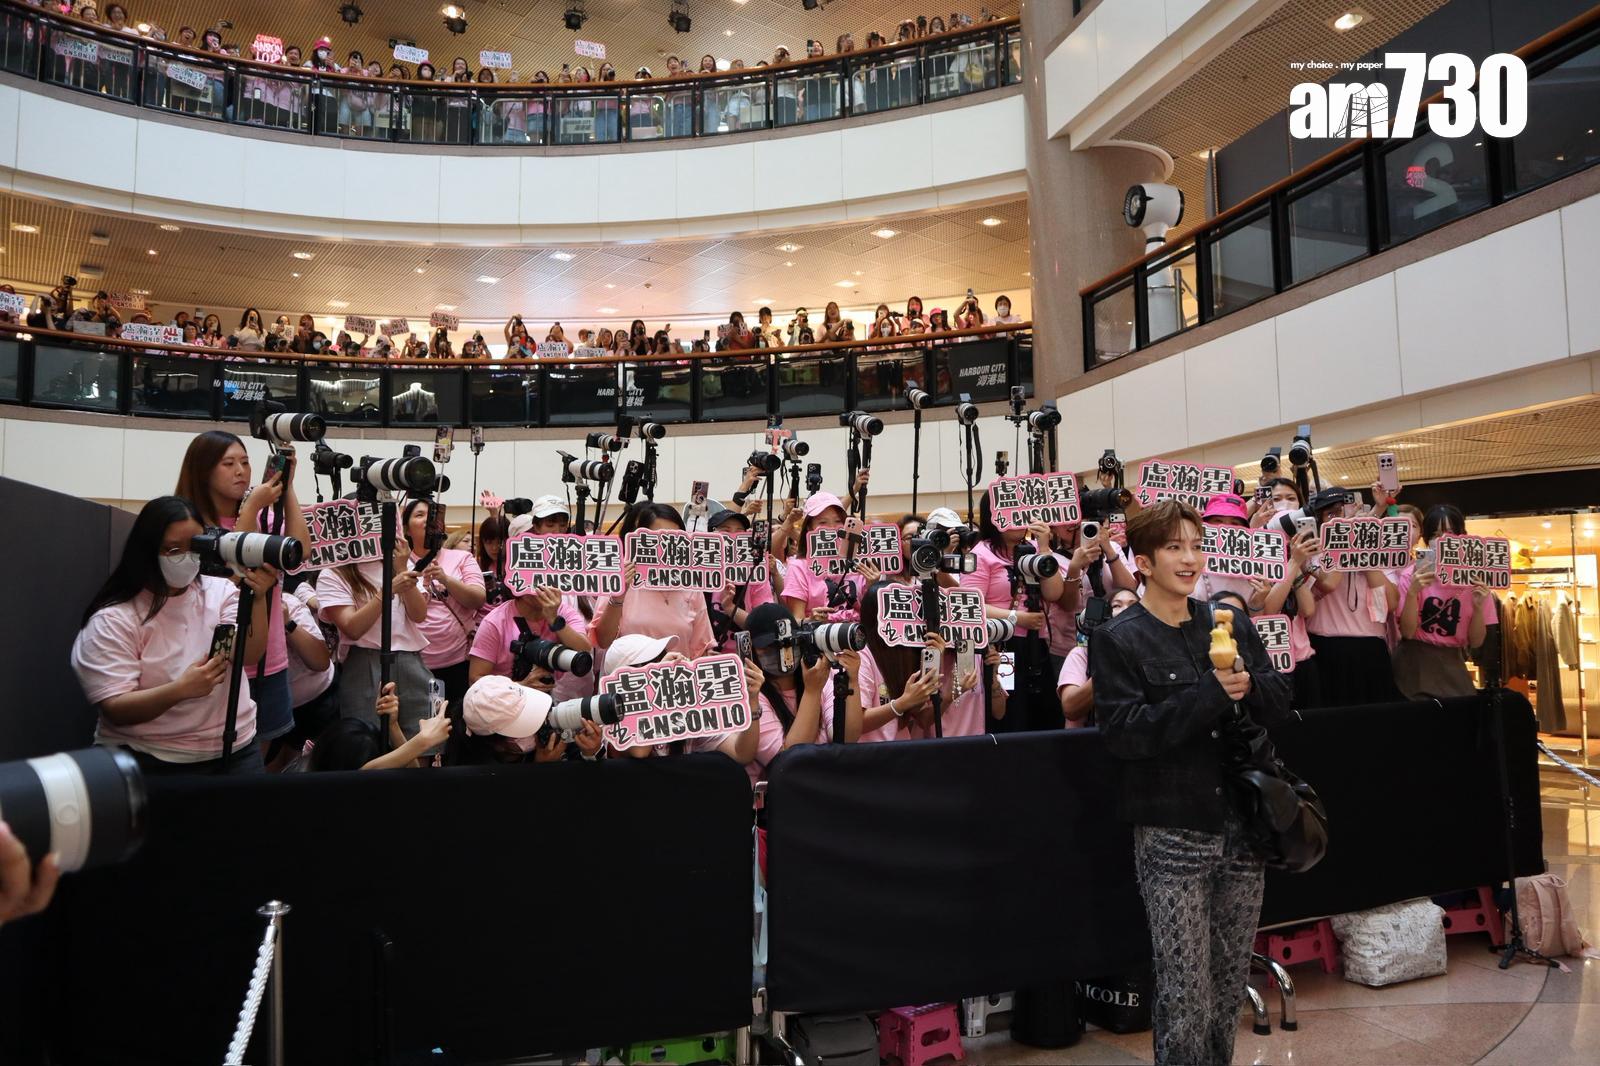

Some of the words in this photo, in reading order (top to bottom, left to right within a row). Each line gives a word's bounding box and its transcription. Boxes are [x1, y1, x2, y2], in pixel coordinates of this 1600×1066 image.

[960, 365, 990, 377] HARBOUR
[991, 363, 1005, 372] CITY
[248, 381, 265, 389] CITY
[1141, 463, 1231, 493] 盧瀚霆
[992, 477, 1077, 509] 盧瀚霆
[1013, 507, 1060, 526] ANSON
[1064, 505, 1078, 521] LO
[1325, 522, 1408, 549] 盧瀚霆
[309, 538, 376, 565] ANSON
[510, 537, 620, 572] 盧瀚霆
[630, 533, 721, 568] 盧瀚霆
[1340, 552, 1389, 567] ANSON
[1392, 551, 1406, 567] LO
[1440, 538, 1508, 568] 盧瀚霆
[885, 556, 899, 571] LO
[1208, 557, 1264, 576] ANSON
[1267, 564, 1283, 579] LO
[533, 573, 598, 592] ANSON
[602, 574, 620, 592] LO
[648, 568, 702, 588] ANSON
[705, 571, 721, 588] LO
[1452, 569, 1493, 586] ANSON
[1496, 571, 1508, 587] LO
[905, 624, 960, 641] ANON
[1273, 652, 1291, 670] LO
[606, 662, 743, 712] 盧瀚霆
[638, 707, 719, 740] ANSON
[722, 703, 745, 728] LO
